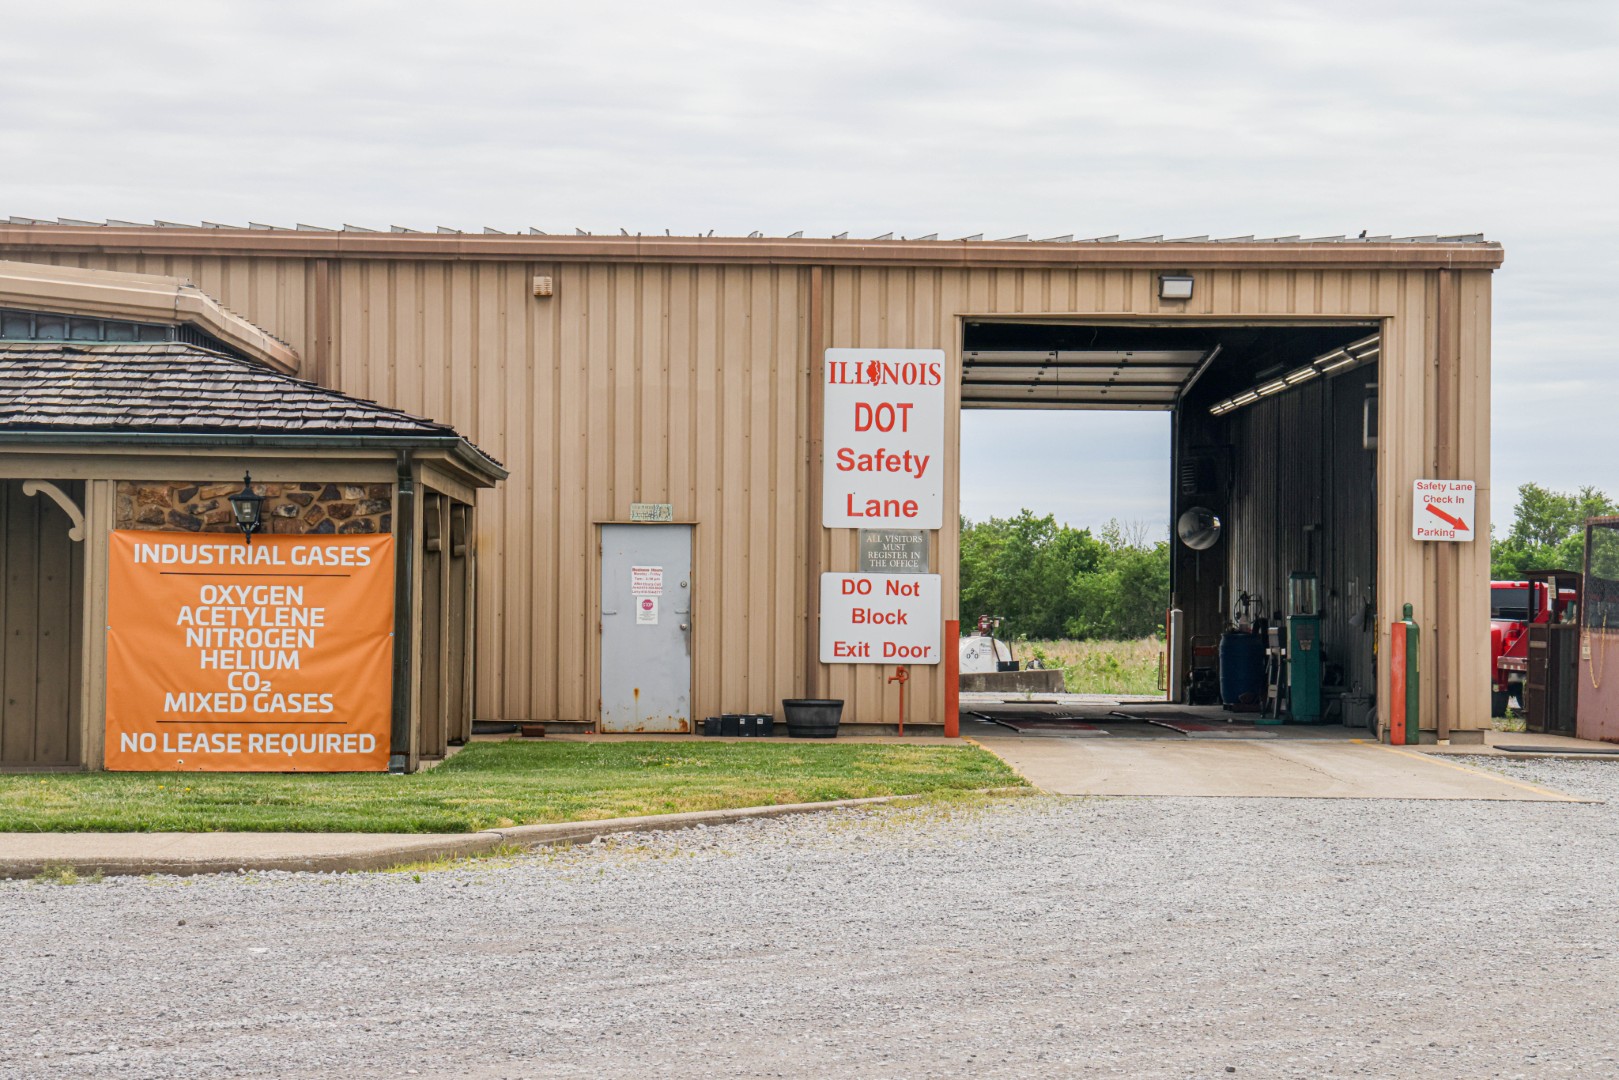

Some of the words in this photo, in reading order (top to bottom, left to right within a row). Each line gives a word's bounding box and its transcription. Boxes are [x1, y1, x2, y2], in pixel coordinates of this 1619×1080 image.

[854, 402, 914, 432] DOT
[836, 448, 930, 478] Safety
[1416, 482, 1446, 492] Safety
[1449, 482, 1472, 491] Lane
[846, 494, 918, 518] Lane
[1423, 495, 1452, 504] Check
[1456, 496, 1464, 504] In
[1417, 528, 1455, 538] Parking
[134, 544, 285, 565] INDUSTRIAL
[291, 546, 371, 566] GASES
[200, 585, 304, 605] OXYGEN
[842, 579, 872, 596] DO
[886, 580, 920, 597] Not
[177, 606, 324, 627] ACETYLENE
[852, 608, 908, 625] Block
[186, 628, 314, 648] NITROGEN
[200, 650, 299, 670] HELIUM
[833, 642, 870, 657] Exit
[883, 642, 931, 658] Door
[164, 692, 247, 712] MIXED
[254, 693, 333, 713] GASES
[121, 733, 156, 752] NO
[164, 733, 242, 753] LEASE
[248, 734, 375, 756] REQUIRED
